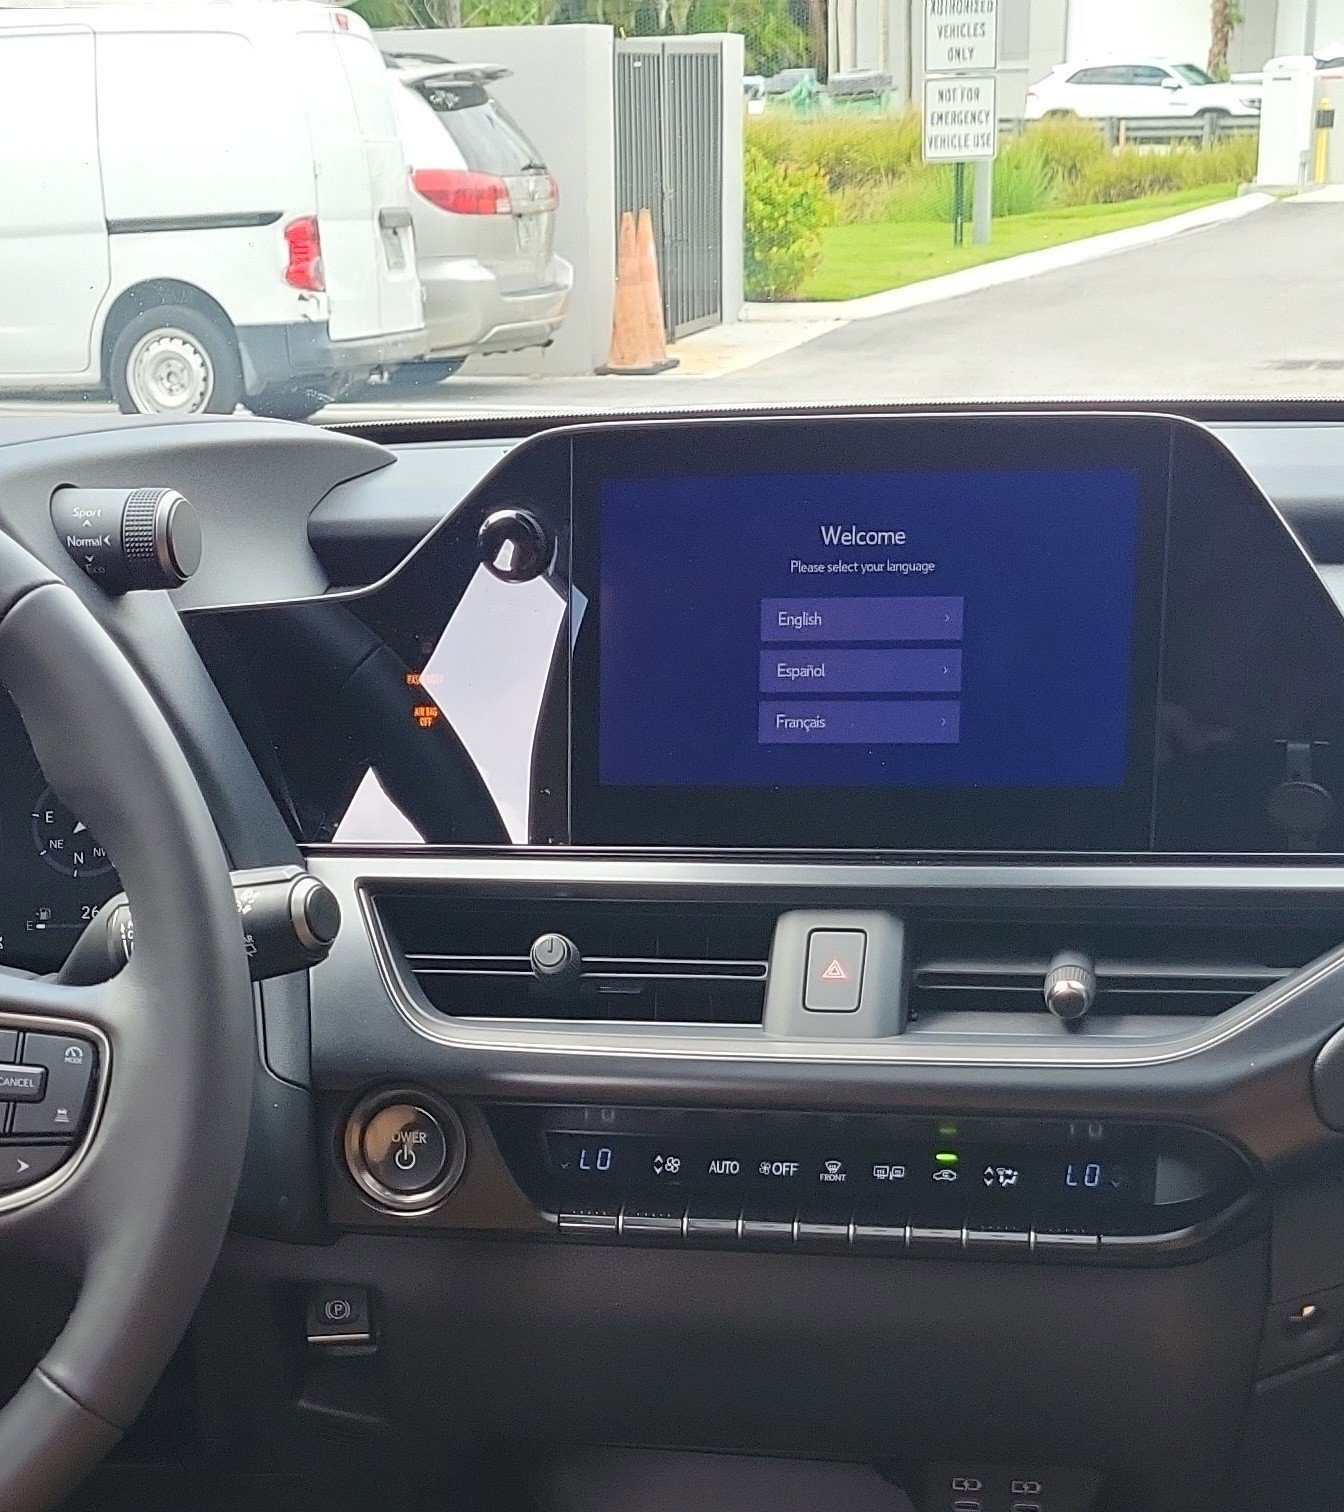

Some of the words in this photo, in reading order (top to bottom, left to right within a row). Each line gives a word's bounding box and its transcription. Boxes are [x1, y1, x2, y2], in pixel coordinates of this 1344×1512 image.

[930, 0, 994, 16] AUTHORIZED
[937, 23, 986, 39] VEHICLES
[947, 47, 974, 63] ONLY
[937, 88, 957, 103] NOT
[960, 86, 980, 101] FOR
[930, 110, 990, 126] EMERGENCY
[927, 134, 970, 150] VEHICLE
[973, 132, 992, 148] USE
[72, 507, 102, 519] Sport
[67, 534, 102, 547] Normal
[820, 525, 906, 546] Welcome
[790, 560, 825, 573] Please
[826, 559, 858, 573] select
[861, 562, 884, 575] your
[886, 559, 936, 575] language
[778, 611, 822, 629] English
[777, 663, 825, 680] Español
[776, 713, 826, 732] Français
[45, 811, 54, 823] E
[49, 839, 64, 850] NE
[73, 851, 84, 865] N
[709, 1160, 739, 1174] AUTO
[772, 1162, 799, 1176] OFF
[819, 1173, 846, 1182] FRONT
